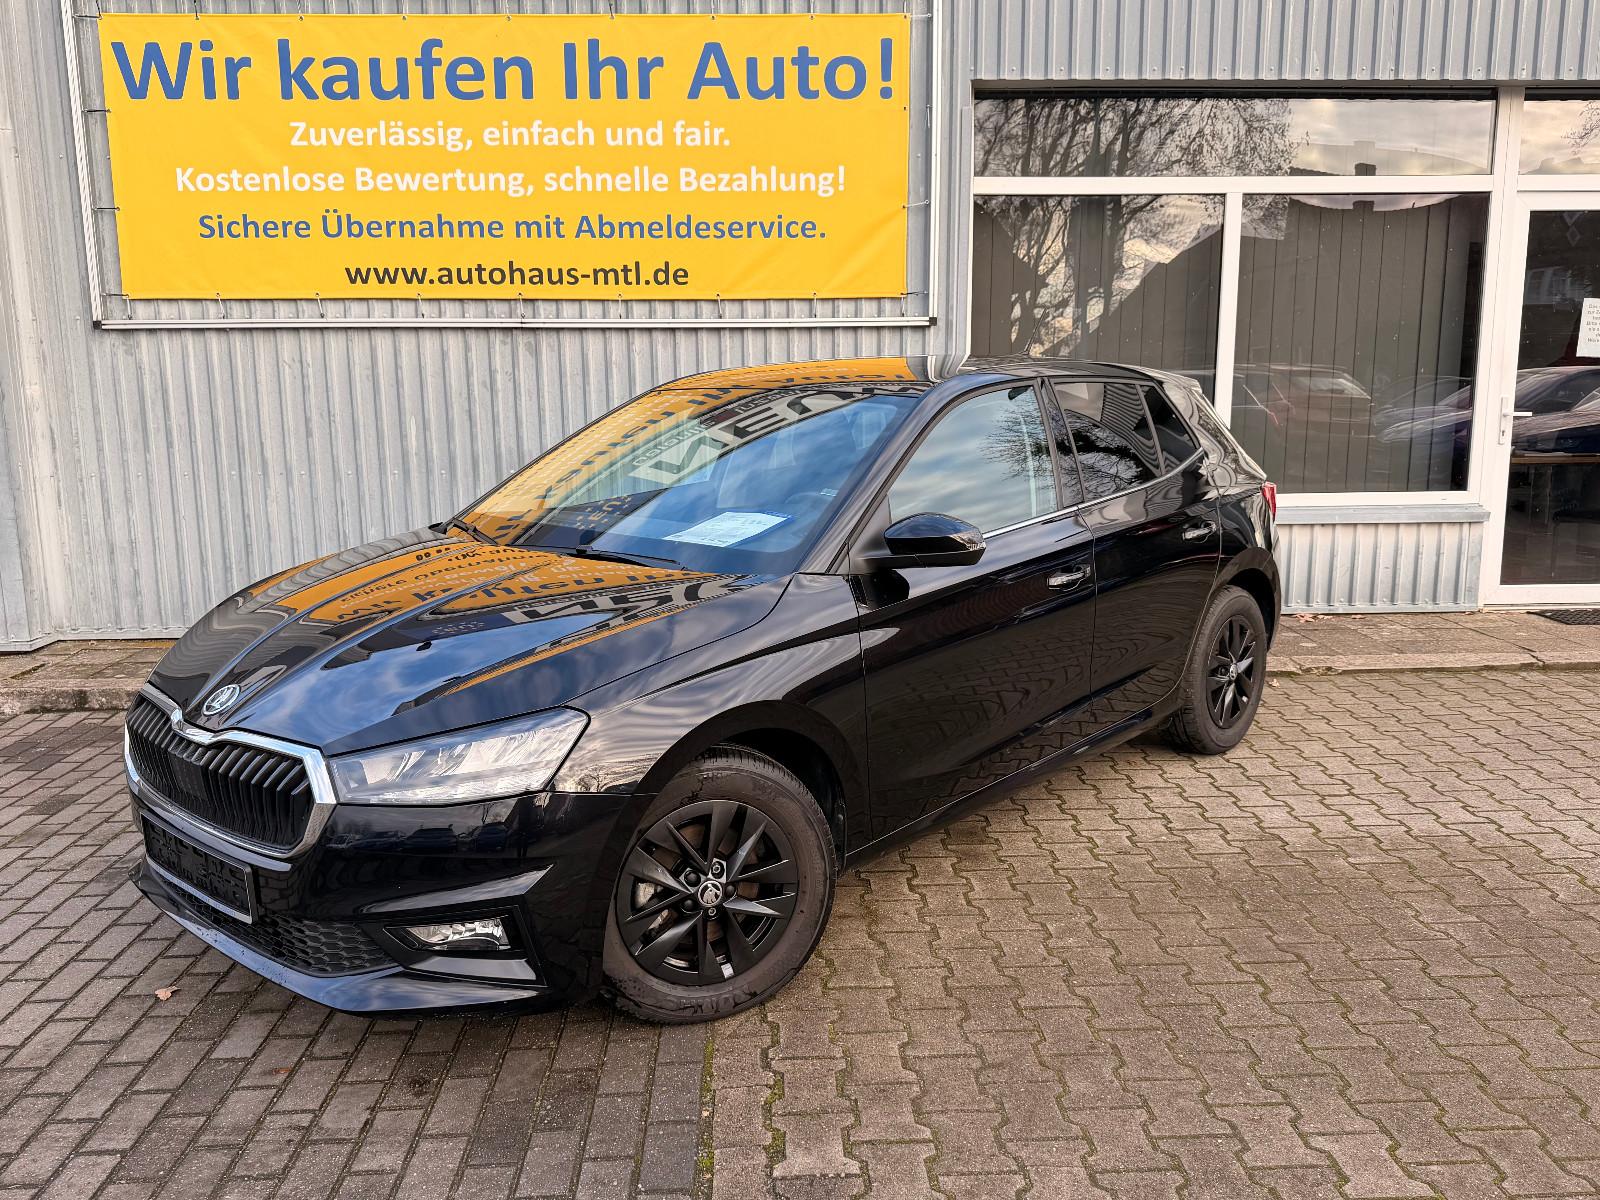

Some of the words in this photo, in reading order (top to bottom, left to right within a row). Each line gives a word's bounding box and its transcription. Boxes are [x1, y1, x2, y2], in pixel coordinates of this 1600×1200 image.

[111, 39, 252, 100] Wir
[277, 38, 534, 101] kaufen
[563, 38, 664, 100] Ihr
[687, 38, 893, 101] Auto!
[289, 120, 473, 153] Zuverlässig,
[482, 119, 595, 146] einfach
[605, 120, 663, 147] und
[673, 119, 731, 147] fair.
[175, 165, 345, 192] Kostenlose
[355, 167, 534, 198] Bewertung,
[544, 165, 669, 192] schnelle
[679, 164, 847, 198] Bezahlung!
[198, 213, 311, 239] Sichere
[321, 209, 504, 239] Übernahme
[515, 213, 565, 239] mit
[575, 213, 827, 240] Abmeldeservice.
[344, 260, 689, 286] www.autohaus-mtl.de
